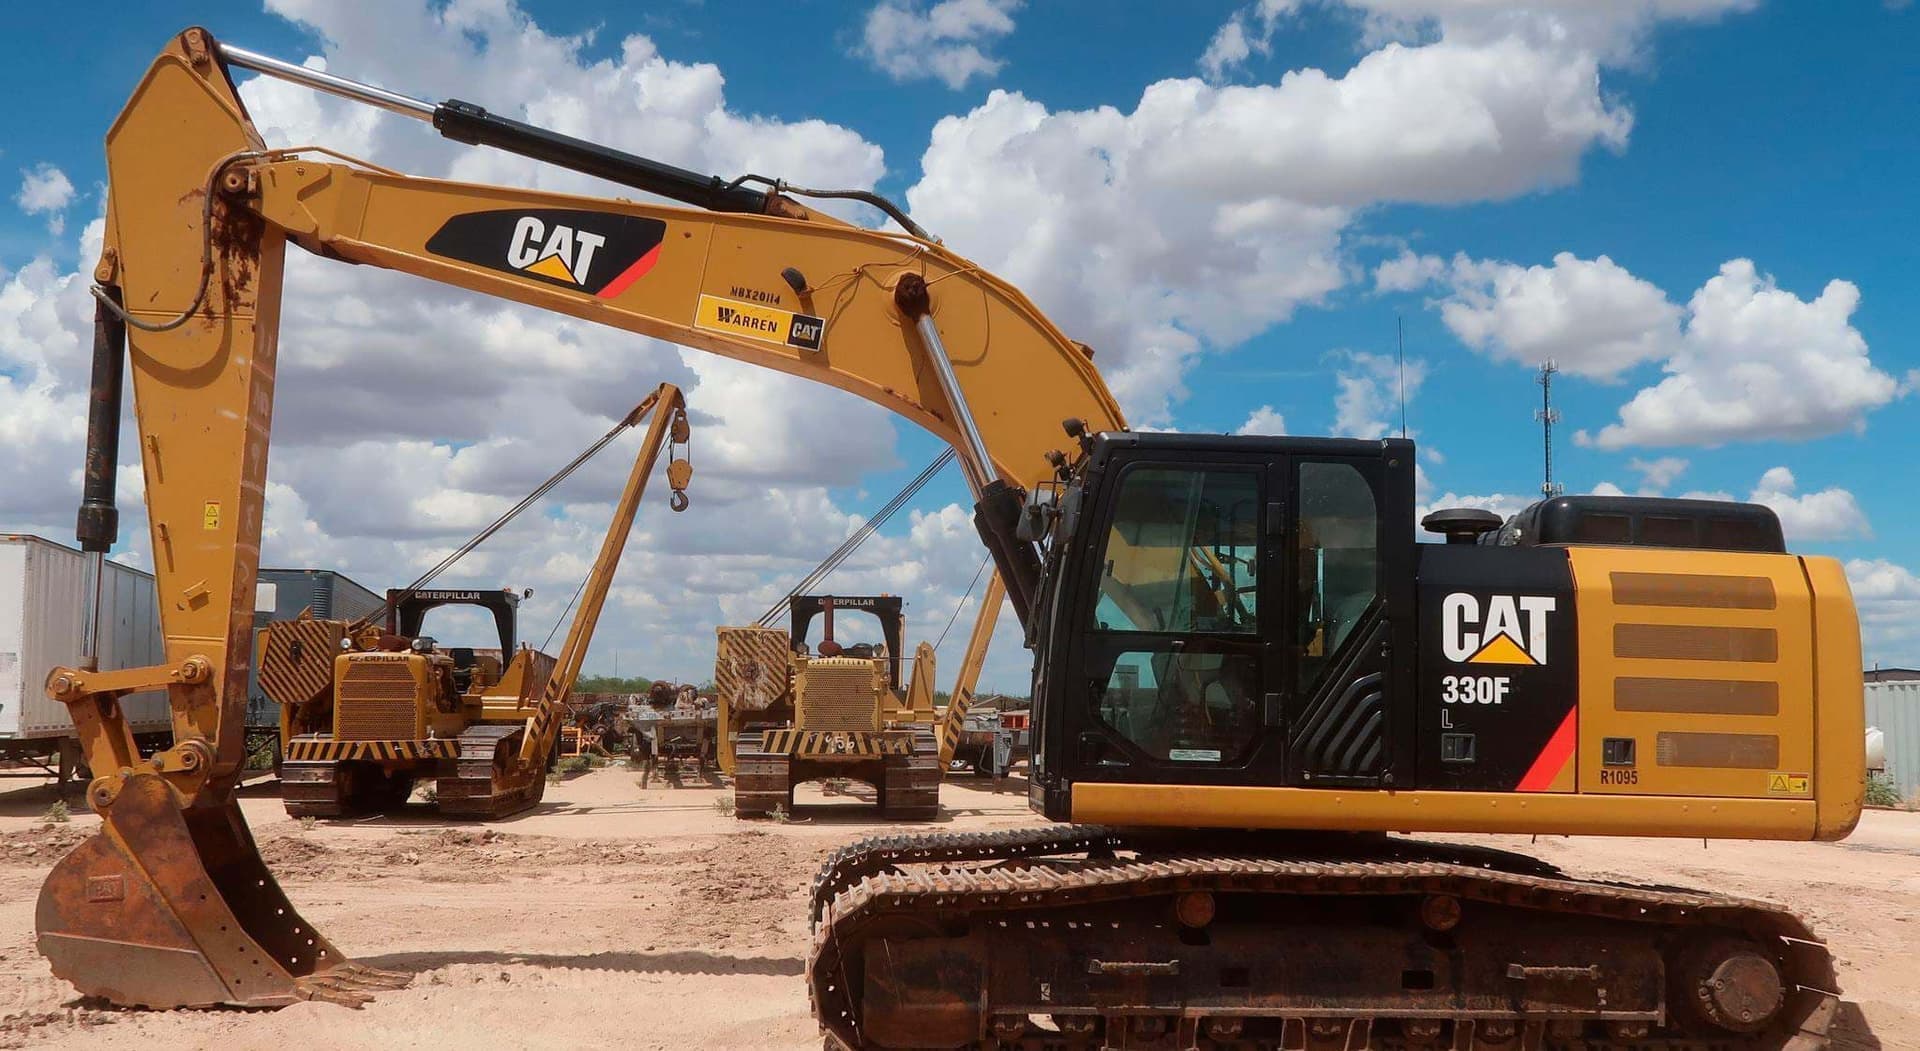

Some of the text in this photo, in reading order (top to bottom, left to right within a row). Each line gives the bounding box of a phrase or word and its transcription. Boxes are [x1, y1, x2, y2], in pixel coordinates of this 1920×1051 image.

[507, 216, 605, 286] CAT
[718, 306, 821, 341] WARREN CAT
[415, 591, 481, 600] CATERPILLAR
[1441, 592, 1556, 665] CAT
[1442, 676, 1510, 704] 330F
[1441, 709, 1453, 729] L
[1600, 770, 1638, 786] R1095
